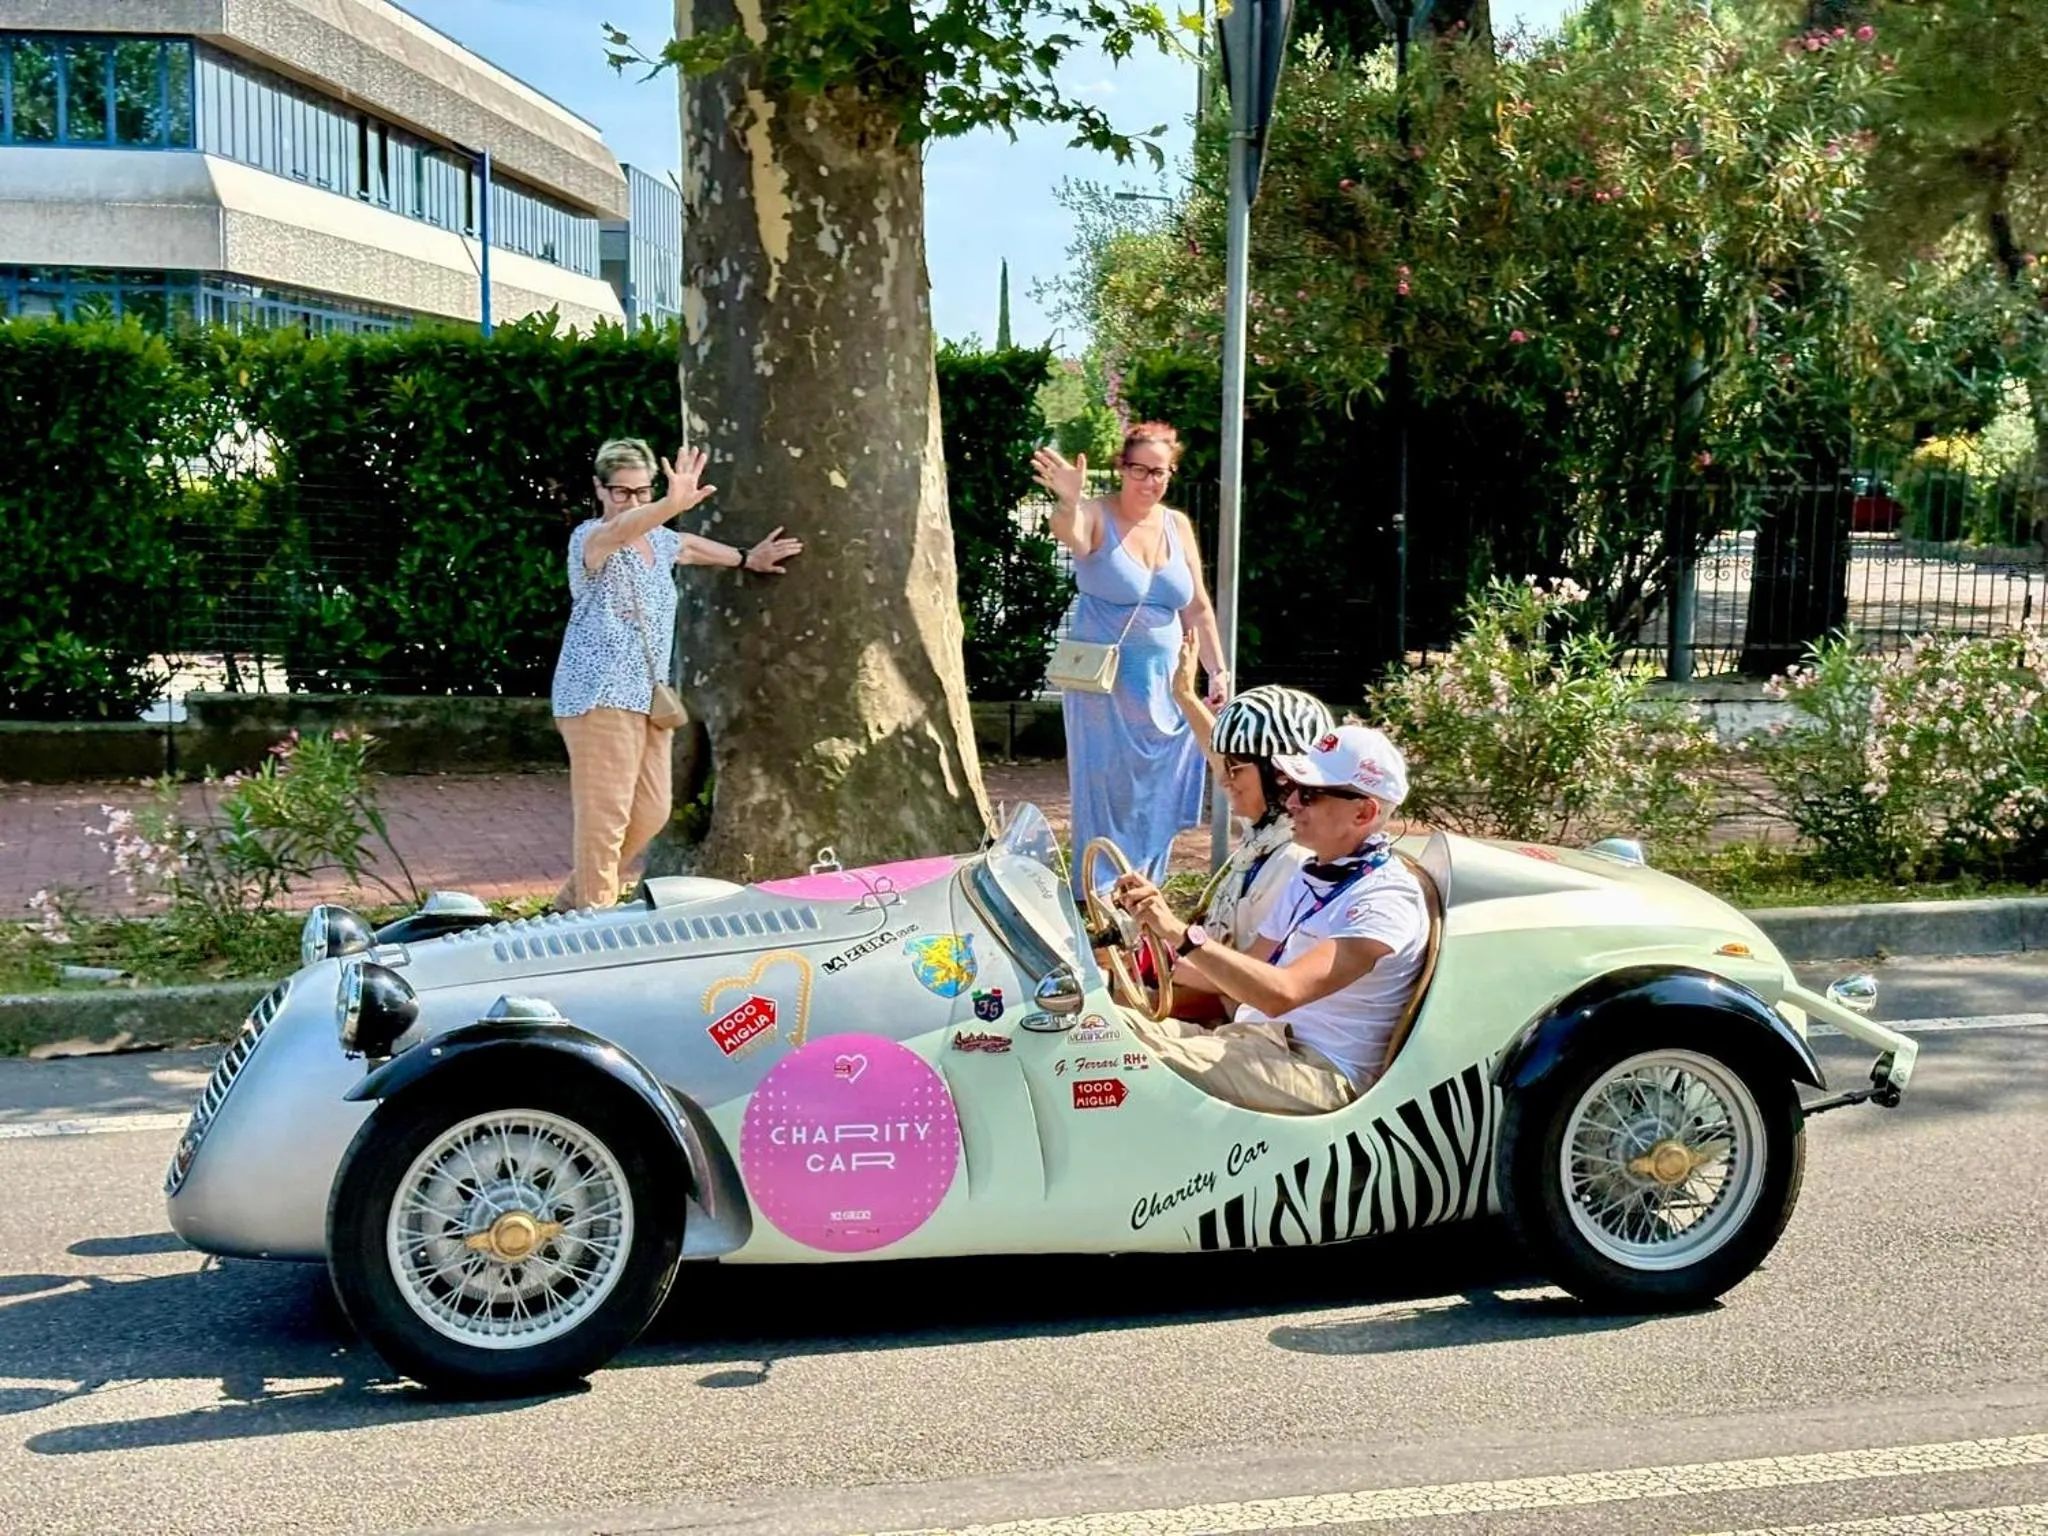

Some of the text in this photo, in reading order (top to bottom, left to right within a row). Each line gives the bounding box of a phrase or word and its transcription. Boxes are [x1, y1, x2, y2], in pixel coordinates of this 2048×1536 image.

[821, 955, 848, 975] LA
[716, 1004, 757, 1035] 1000
[723, 1014, 770, 1050] MIGLIA
[1075, 1057, 1119, 1072] Ferrari
[1077, 1082, 1114, 1094] 1000
[1076, 1094, 1117, 1107] MIGLIA
[770, 1122, 931, 1145] CHARITY
[806, 1151, 897, 1173] CAR
[1130, 1140, 1270, 1231] Charity Car
